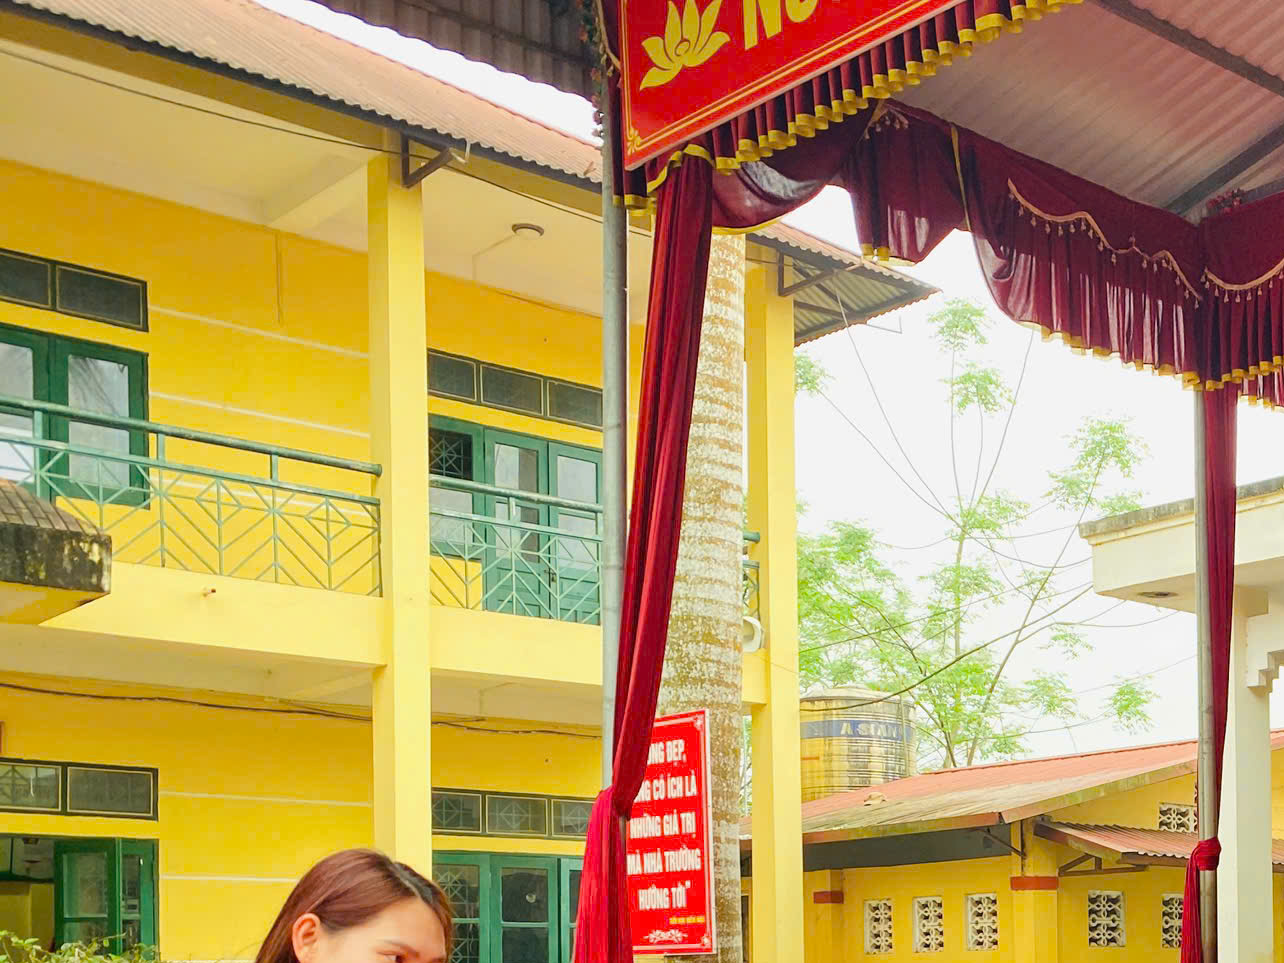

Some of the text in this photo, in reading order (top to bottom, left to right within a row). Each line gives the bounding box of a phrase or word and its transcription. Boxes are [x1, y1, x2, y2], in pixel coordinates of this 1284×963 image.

[663, 808, 680, 836] GIÁ
[679, 811, 696, 839] TRỊ
[642, 848, 663, 875] NHÀ
[663, 844, 702, 873] TRƯỜNG
